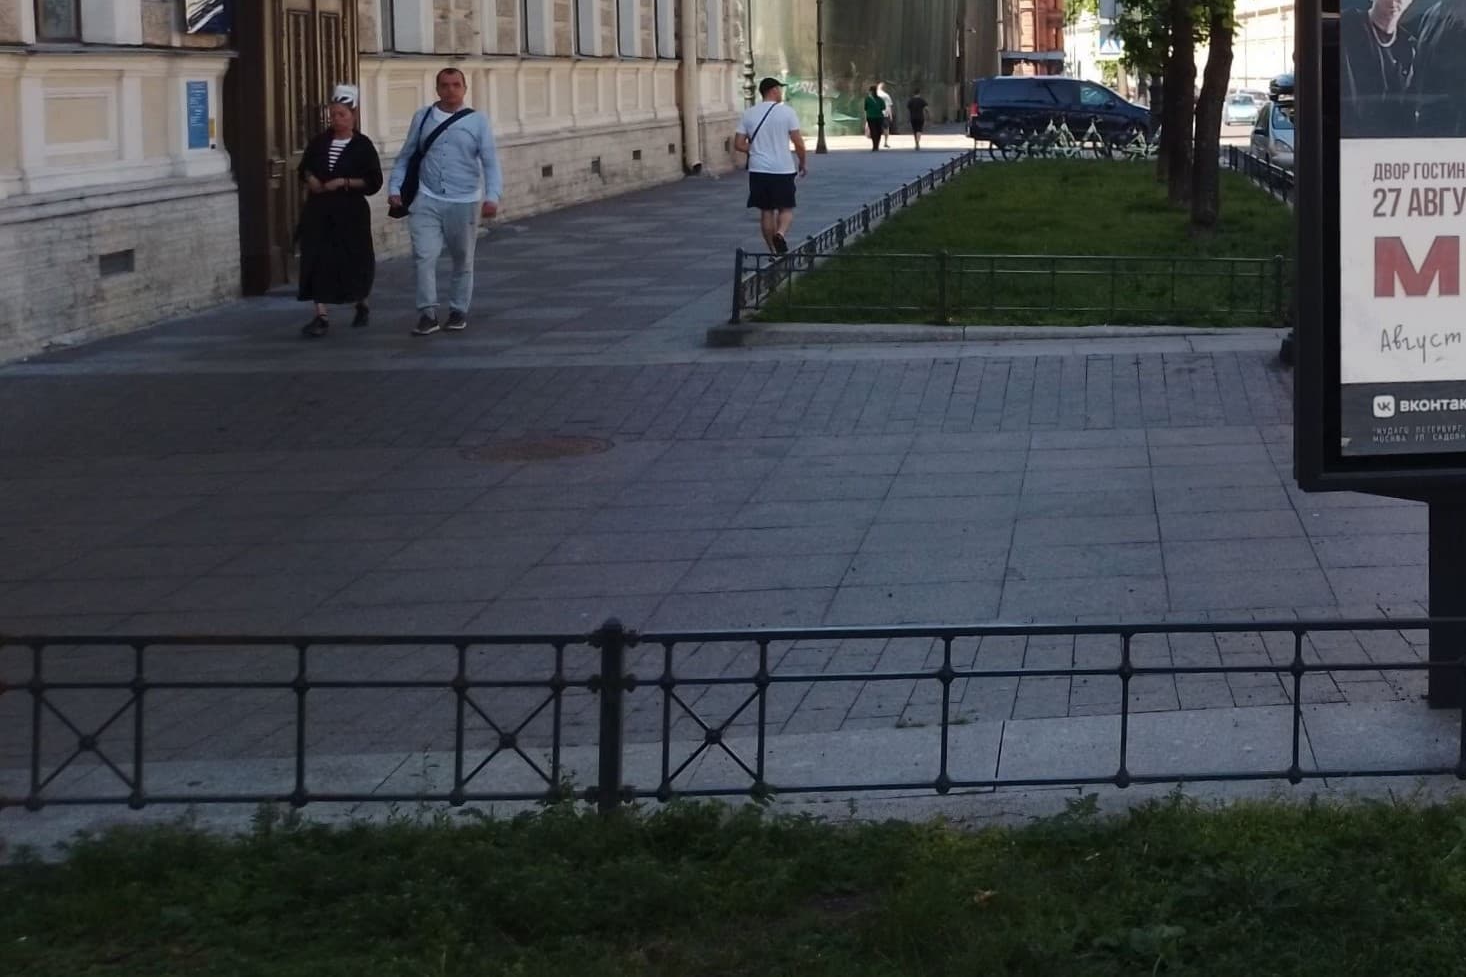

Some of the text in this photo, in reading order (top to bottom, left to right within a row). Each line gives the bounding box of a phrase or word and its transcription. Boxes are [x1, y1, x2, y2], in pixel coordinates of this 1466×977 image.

[1373, 163, 1411, 184] ДВОР
[1373, 188, 1402, 218] 27
[1380, 325, 1462, 363] Август
